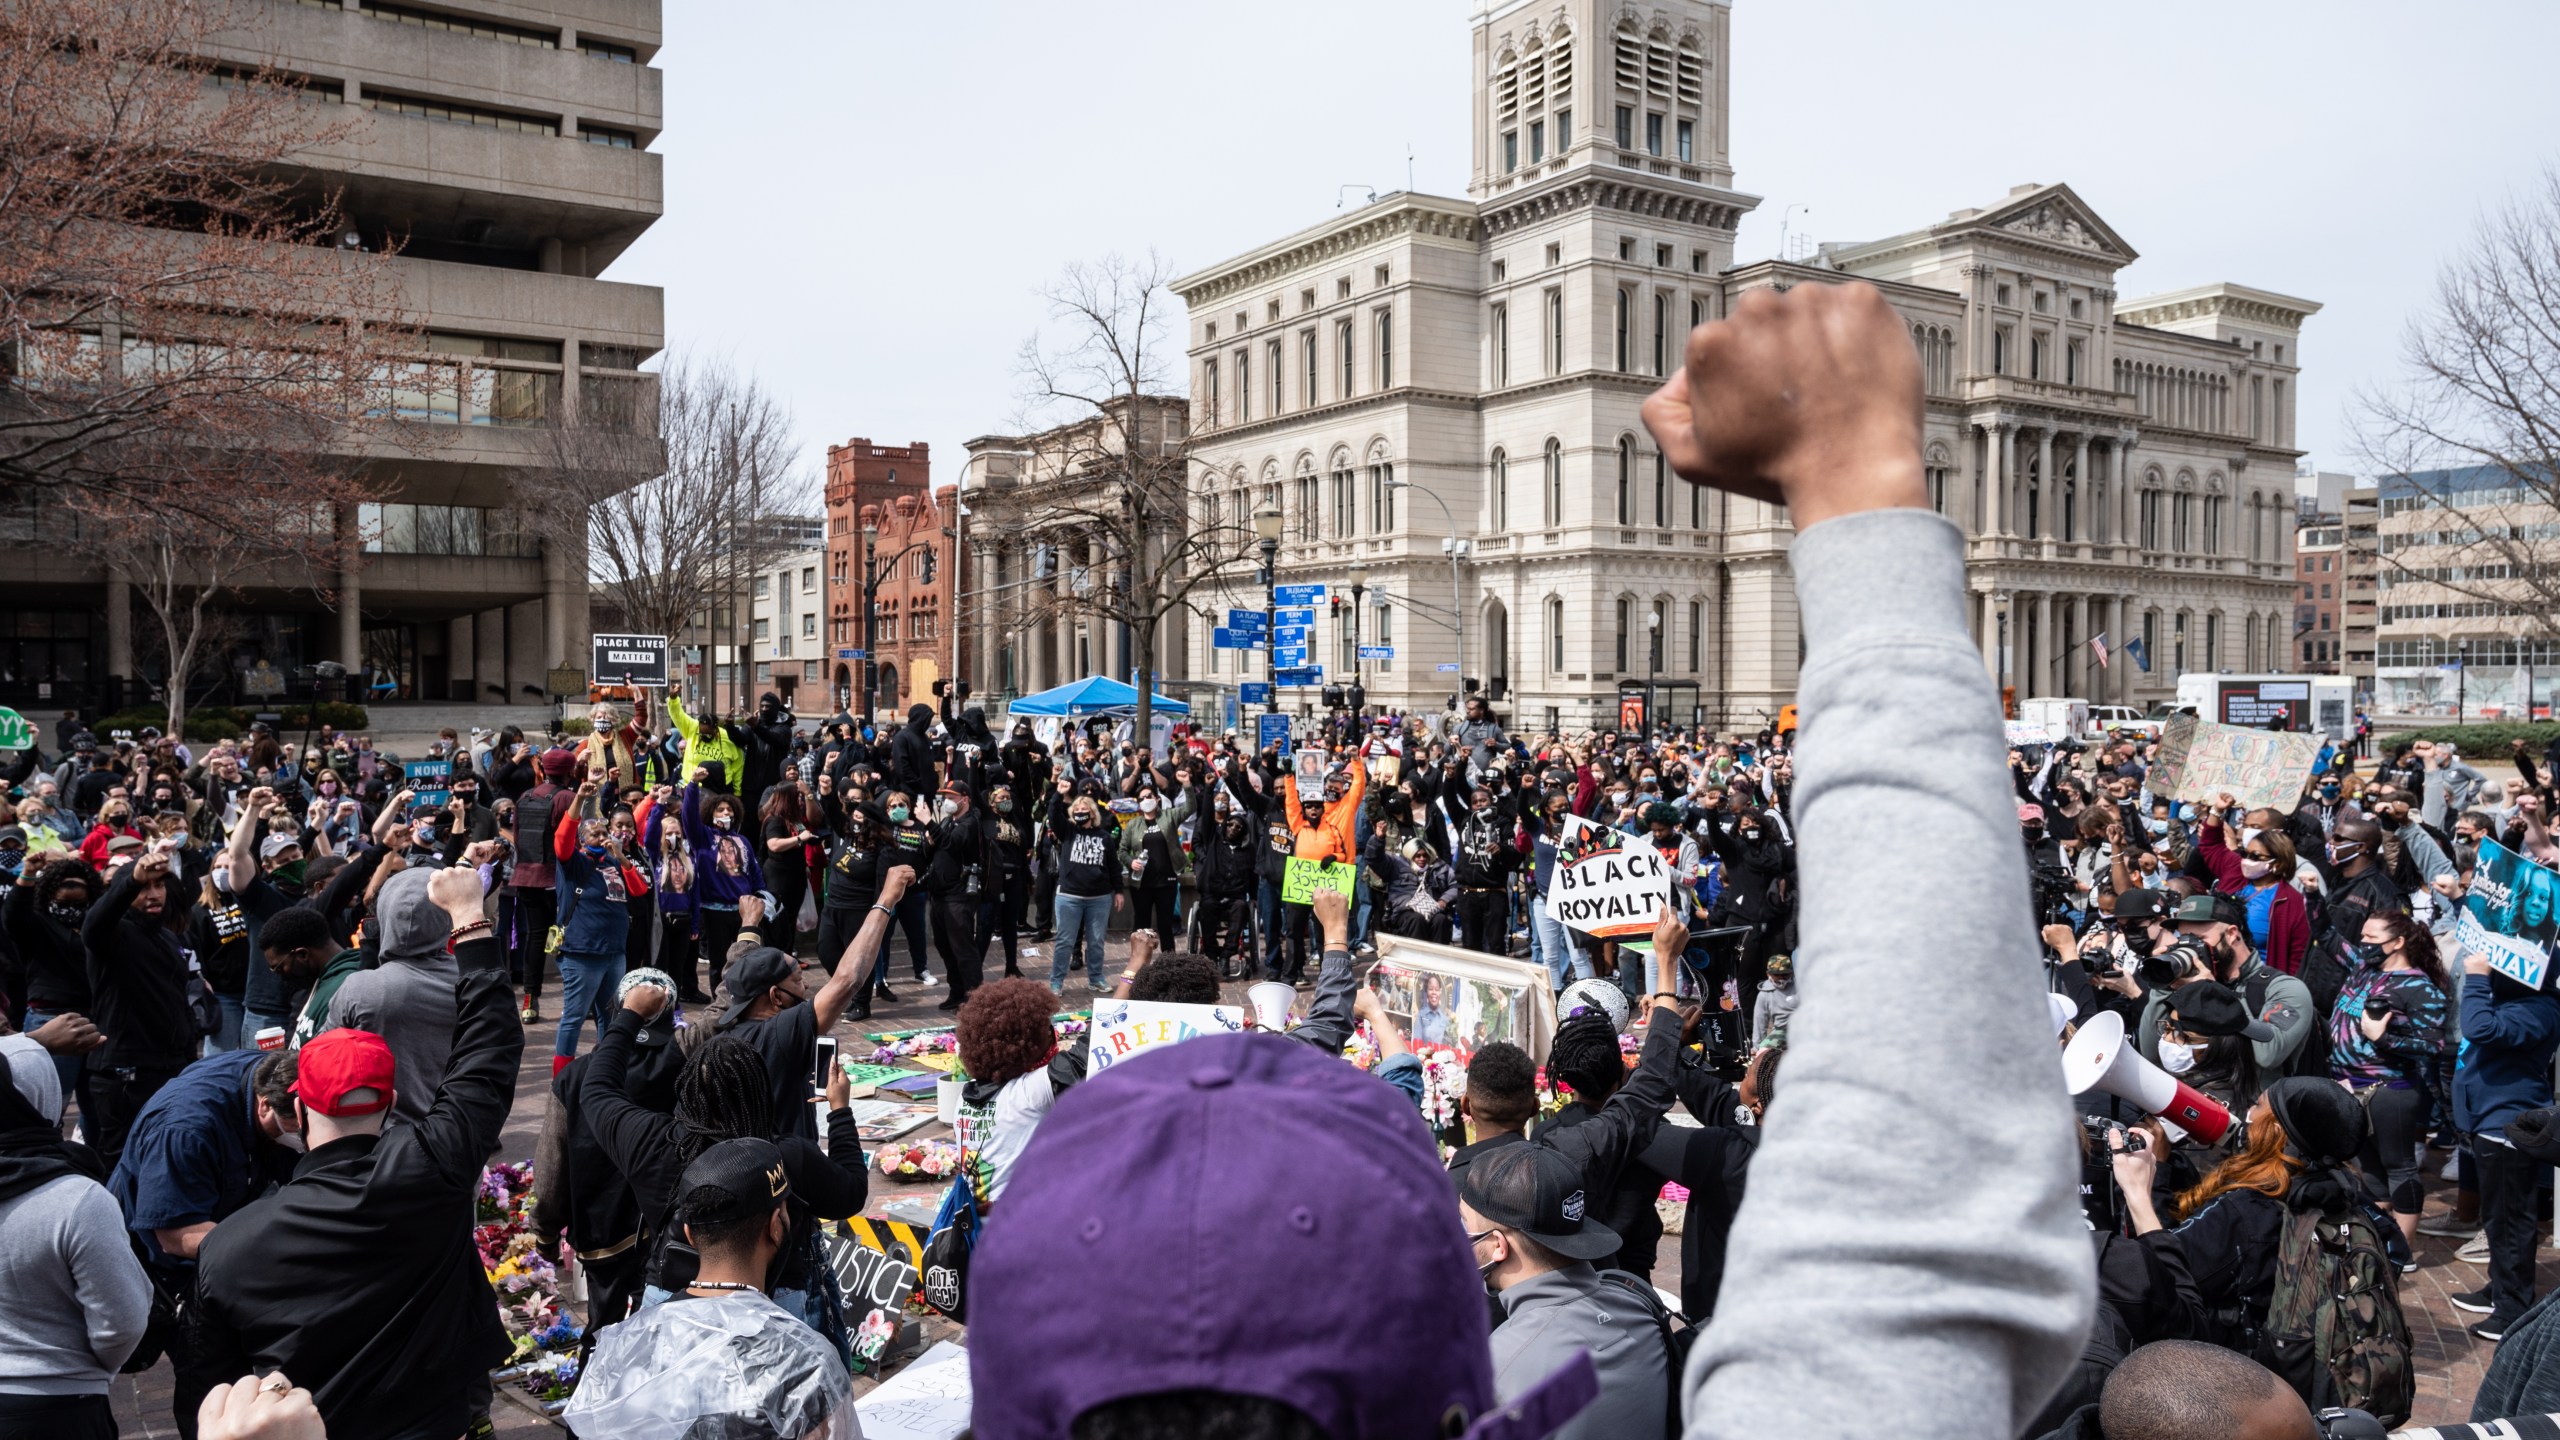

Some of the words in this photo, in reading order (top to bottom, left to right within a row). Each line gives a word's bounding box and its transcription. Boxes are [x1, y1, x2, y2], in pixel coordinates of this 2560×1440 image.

[1245, 612, 1259, 620] PLATA
[1286, 611, 1302, 619] PERM
[1282, 628, 1296, 636] LEEDS
[596, 638, 630, 648] BLACK
[636, 639, 665, 649] LIVES
[612, 653, 651, 662] MATTER
[1283, 648, 1298, 656] MAINZ
[1367, 648, 1389, 658] Jefferson
[414, 764, 448, 777] NONE
[406, 778, 444, 791] Rosie
[421, 794, 437, 805] OF
[1076, 834, 1104, 846] BLACK
[1070, 850, 1104, 866] MATTER
[1560, 855, 1663, 890] BLACK
[1292, 872, 1339, 891] BLACK
[1558, 891, 1668, 921] ROYALTY
[2456, 921, 2539, 982] #BREEWAY
[1091, 1020, 1208, 1070] BREEW
[829, 1238, 918, 1314] USTICE
[929, 1268, 958, 1288] 107.5
[927, 1284, 957, 1306] WGCI
[841, 1294, 853, 1310] for
